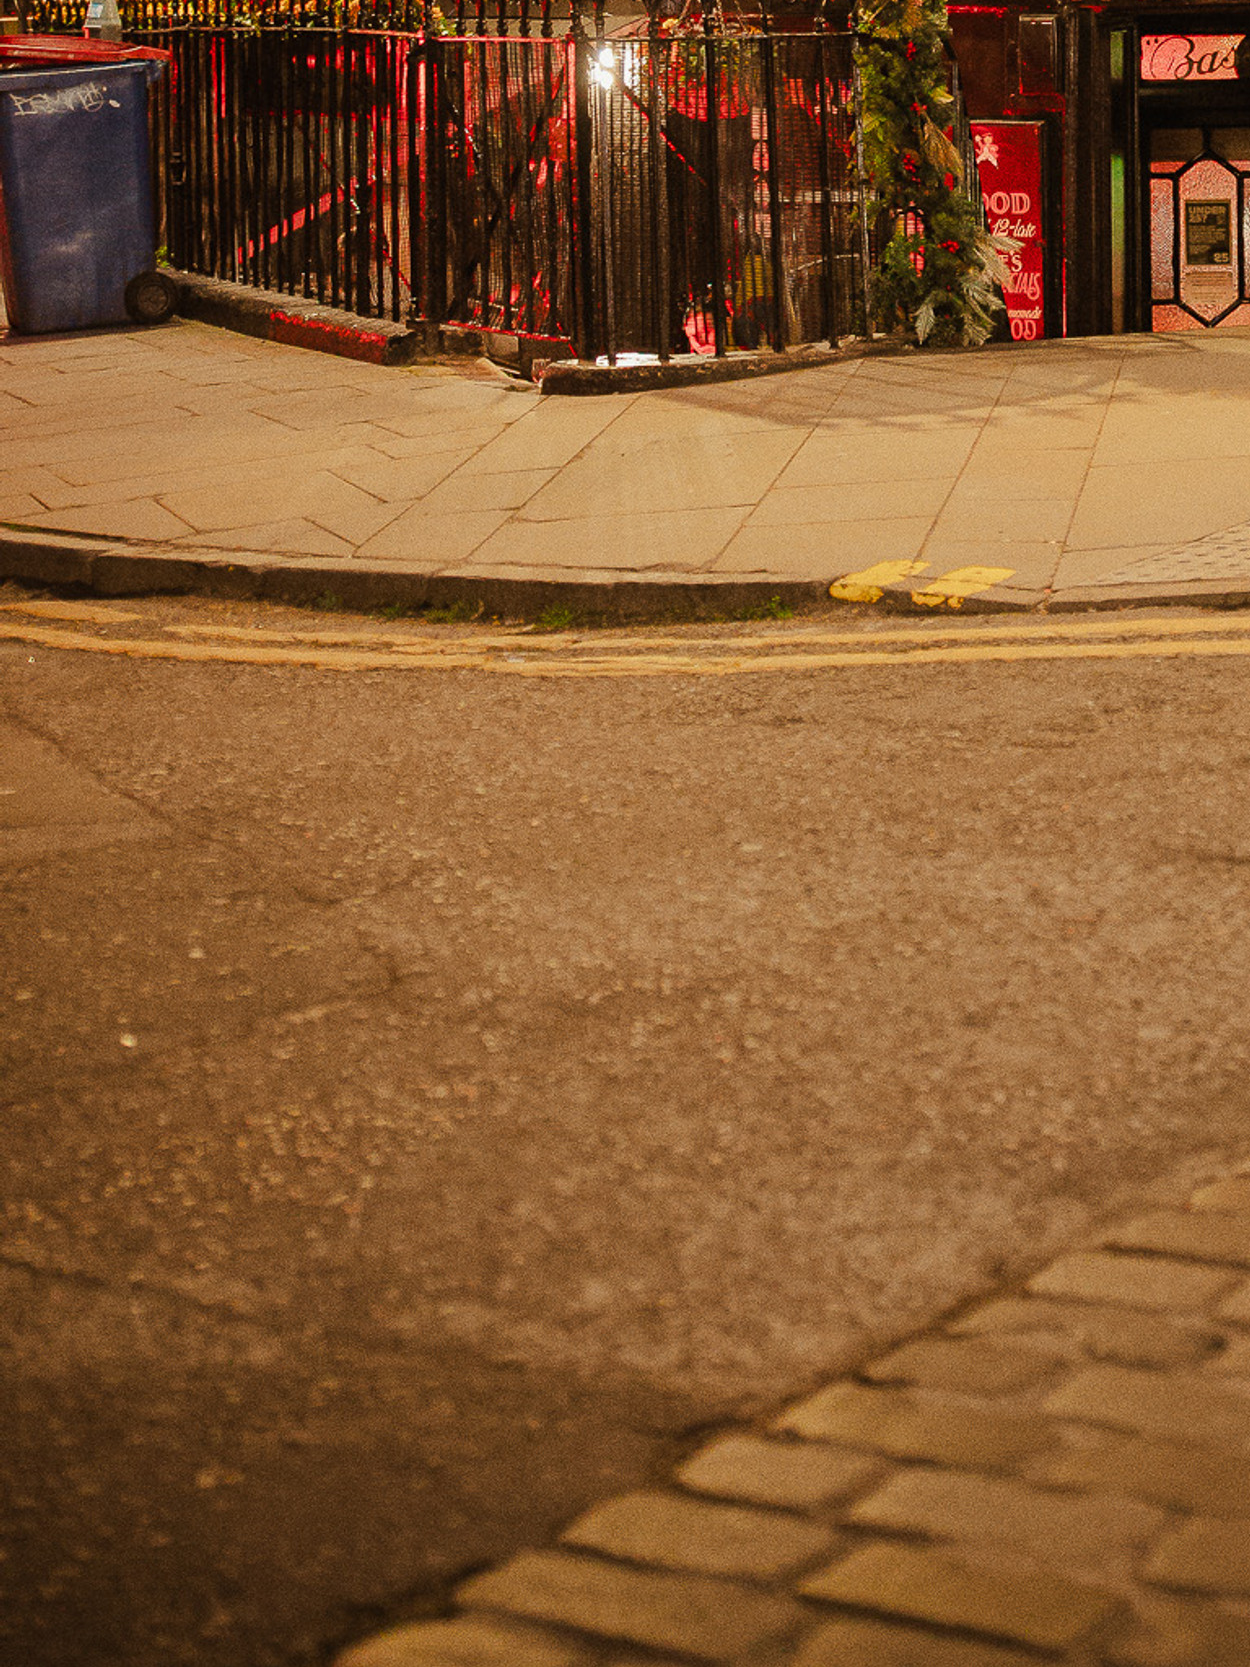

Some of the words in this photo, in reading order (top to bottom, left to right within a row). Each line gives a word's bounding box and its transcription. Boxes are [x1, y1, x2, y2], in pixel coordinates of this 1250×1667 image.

[982, 191, 1030, 215] OD
[1188, 205, 1227, 215] UNDER
[1213, 252, 1230, 263] 25
